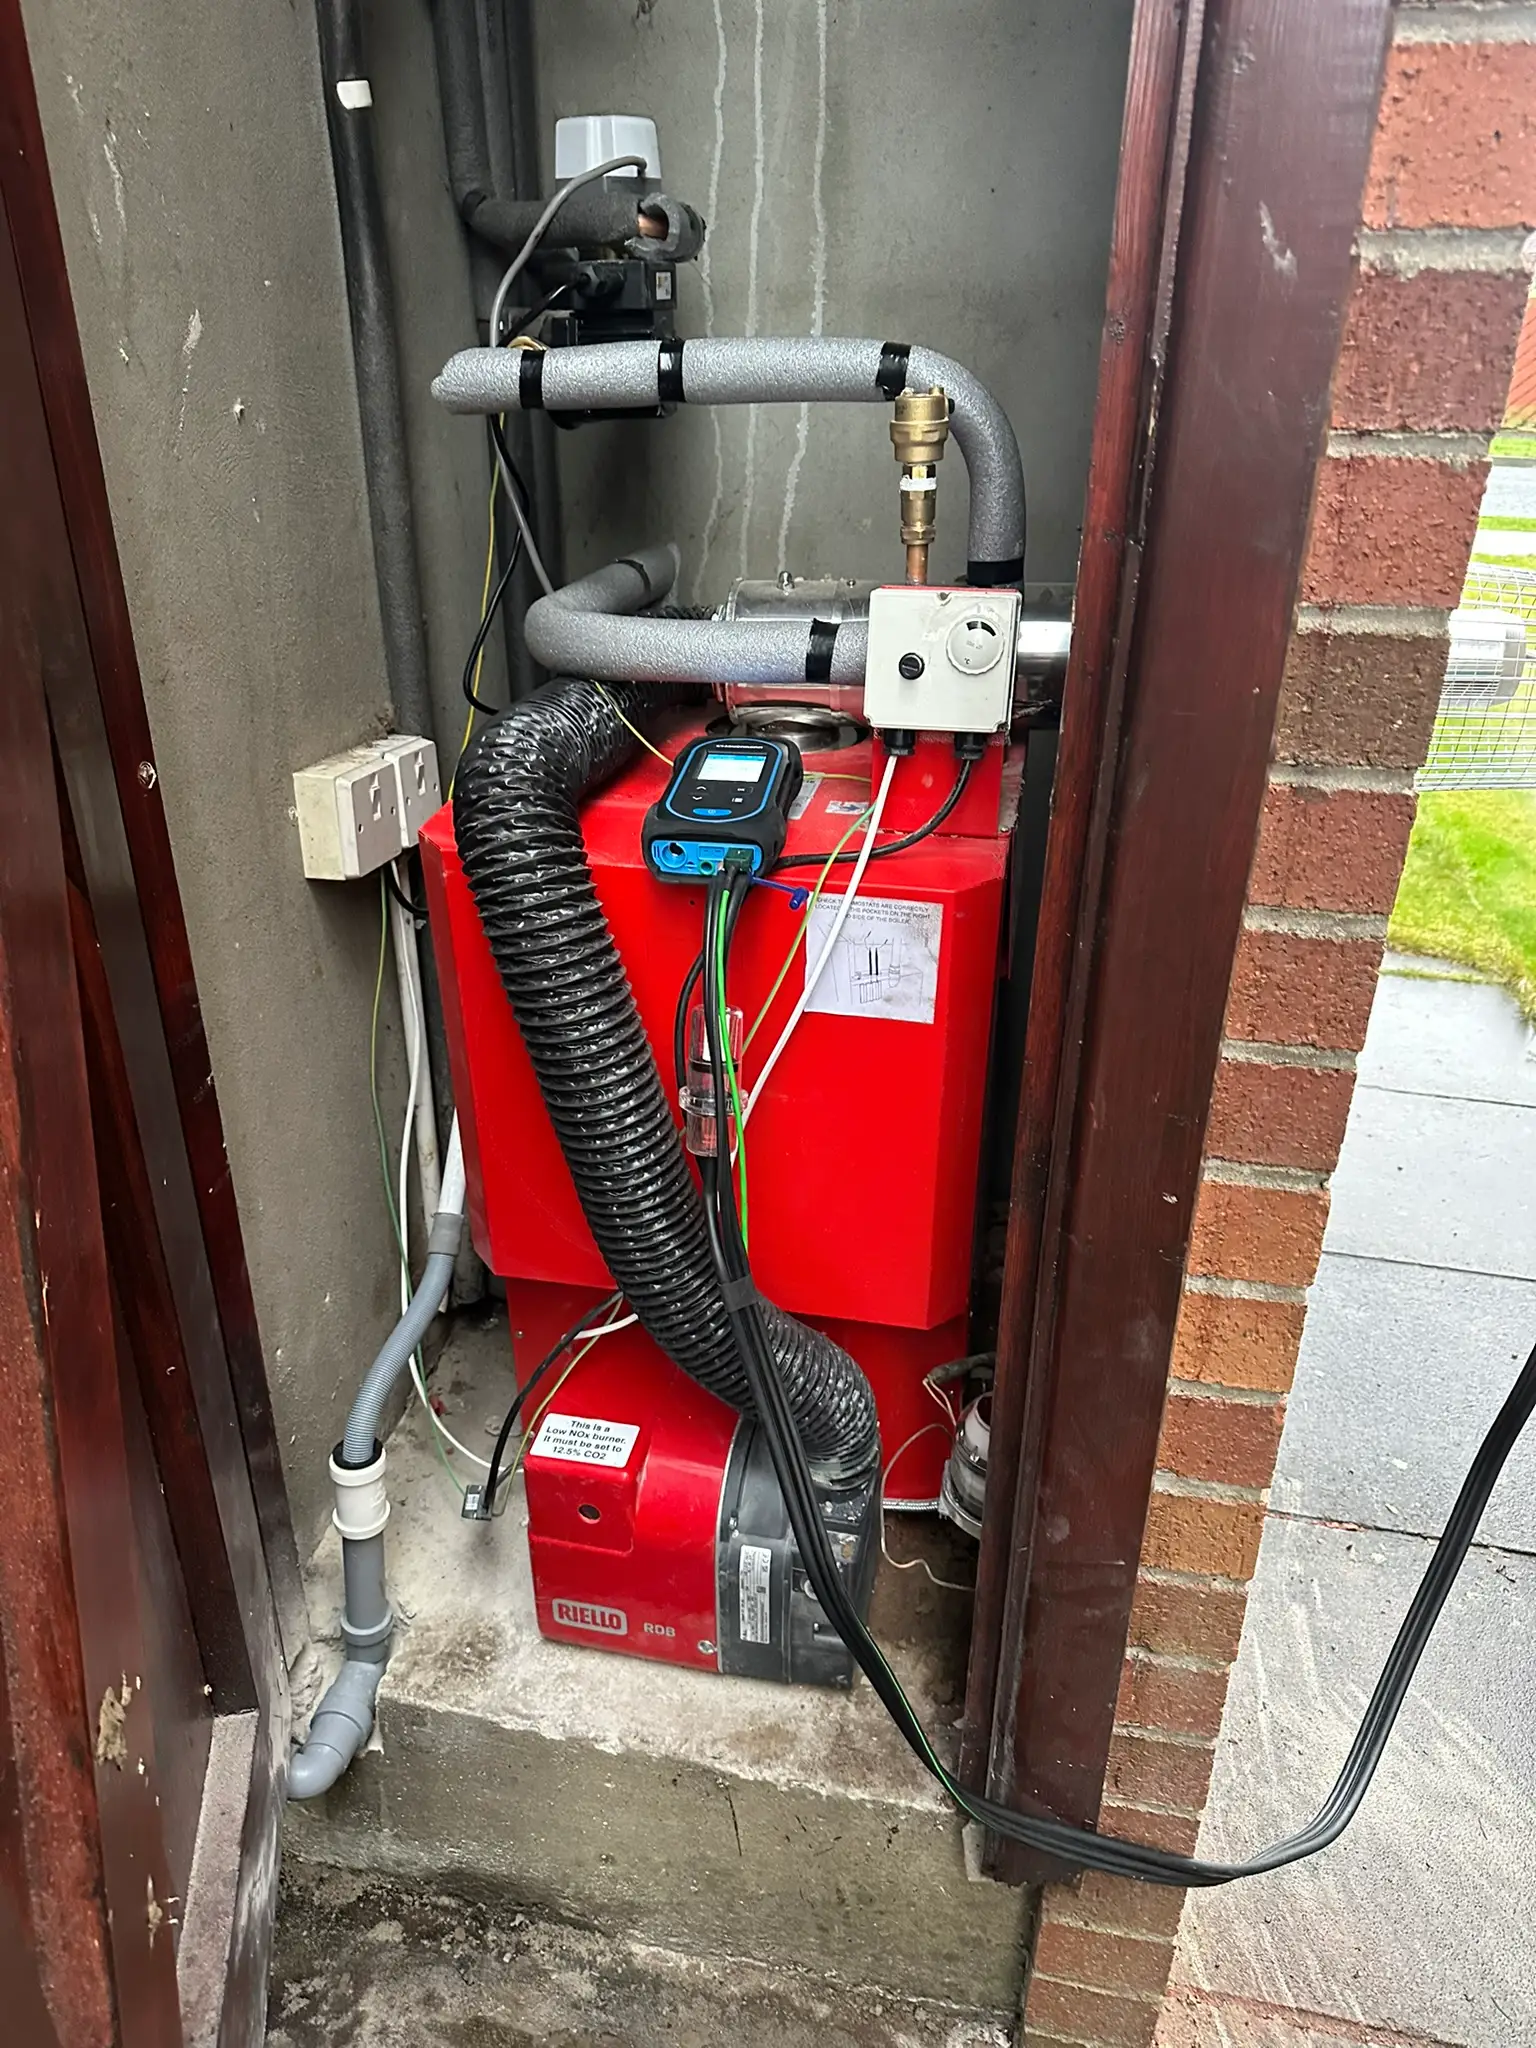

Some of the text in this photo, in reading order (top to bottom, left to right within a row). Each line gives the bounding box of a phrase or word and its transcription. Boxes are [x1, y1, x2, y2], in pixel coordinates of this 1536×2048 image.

[894, 904, 930, 913] CORRECTLY
[571, 1420, 591, 1430] This
[592, 1423, 602, 1432] is
[546, 1426, 626, 1445] Low NOx burner.
[552, 1437, 578, 1447] must
[579, 1440, 592, 1449] be
[594, 1443, 610, 1451] set
[612, 1445, 622, 1453] to
[553, 1446, 607, 1460] 12.5% CO2
[557, 1603, 622, 1630] RIELLO
[643, 1622, 676, 1638] RDB
